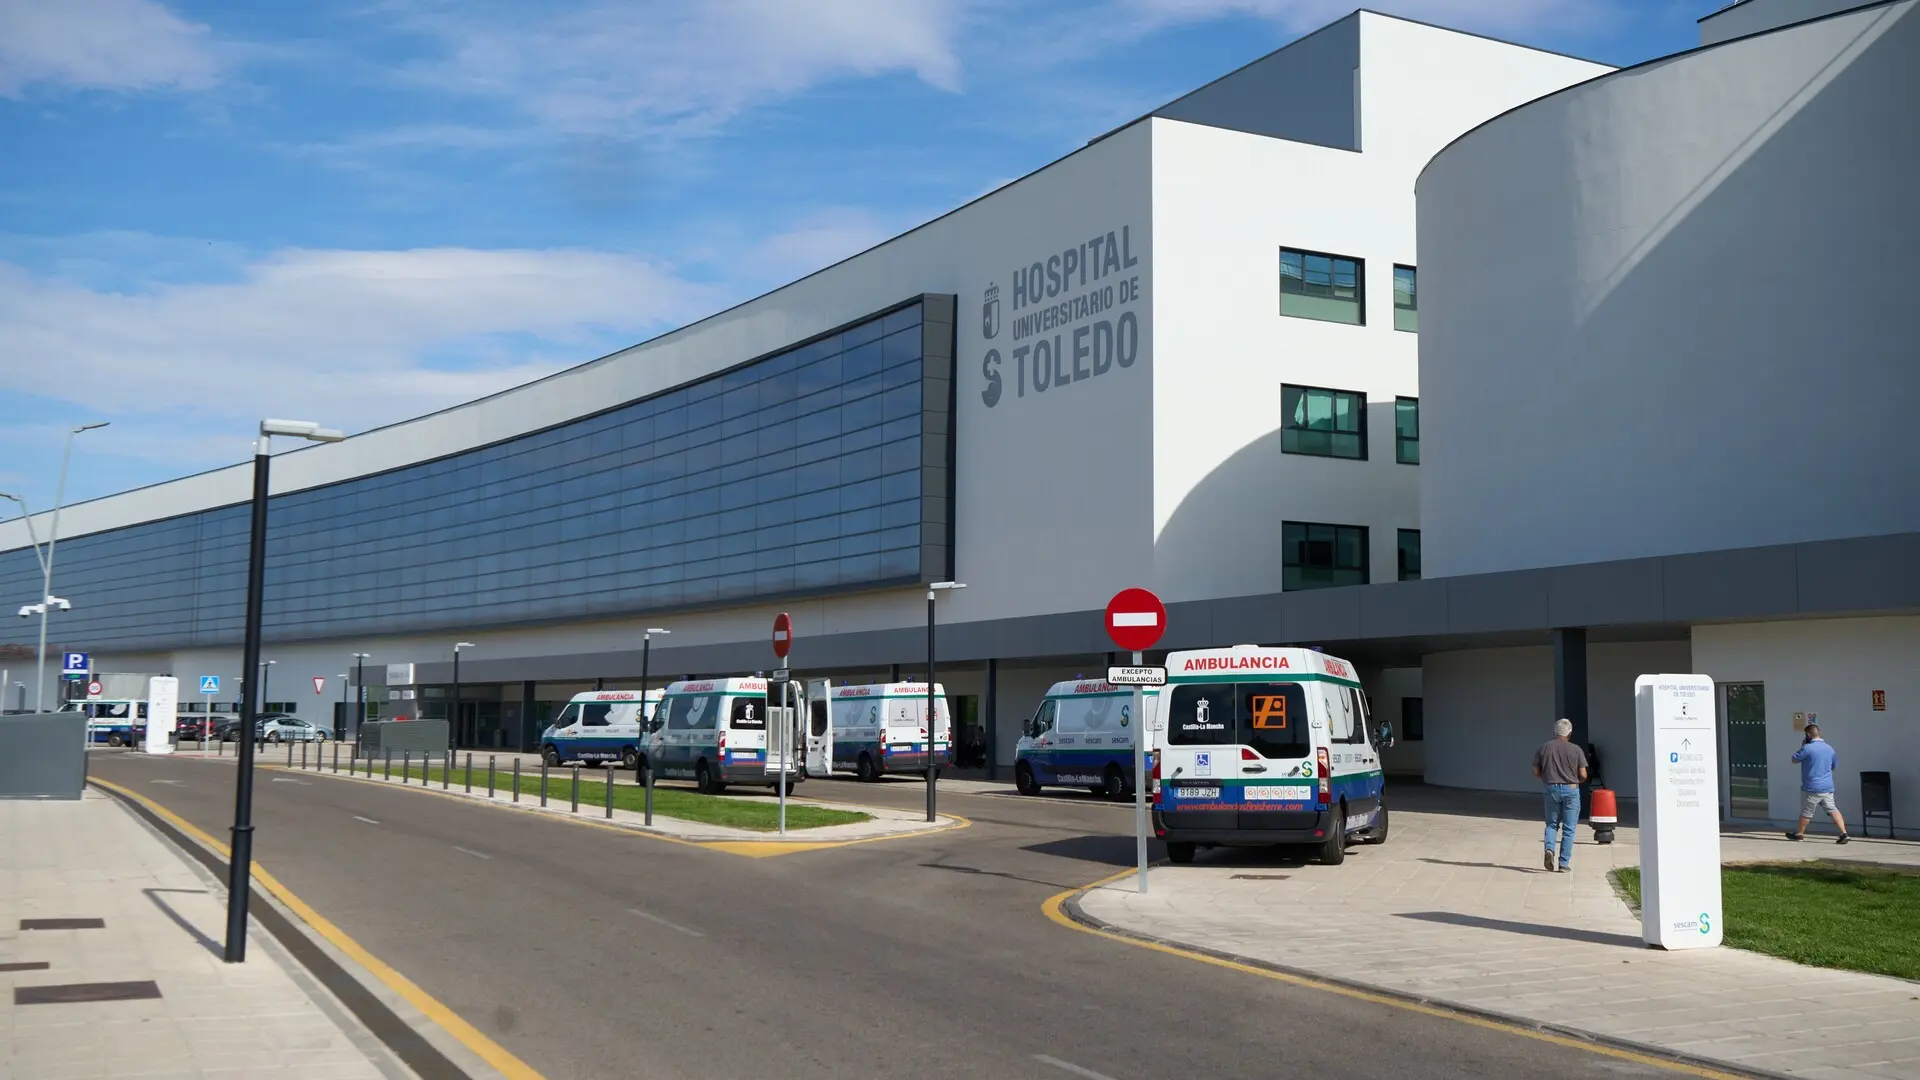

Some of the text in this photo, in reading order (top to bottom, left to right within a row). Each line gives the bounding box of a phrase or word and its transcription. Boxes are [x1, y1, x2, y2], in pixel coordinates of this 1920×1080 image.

[1013, 225, 1138, 311] HOSPITAL
[1013, 276, 1139, 341] UNIVERSITARIO DE
[1012, 311, 1138, 398] TOLEDO
[69, 653, 83, 669] P
[1184, 656, 1290, 671] AMBULANCIA
[682, 682, 715, 693] AMBULANCIA
[1074, 683, 1118, 693] AMBULANCIA
[1179, 787, 1217, 797] 9189 JZH
[1673, 921, 1698, 929] sescam
